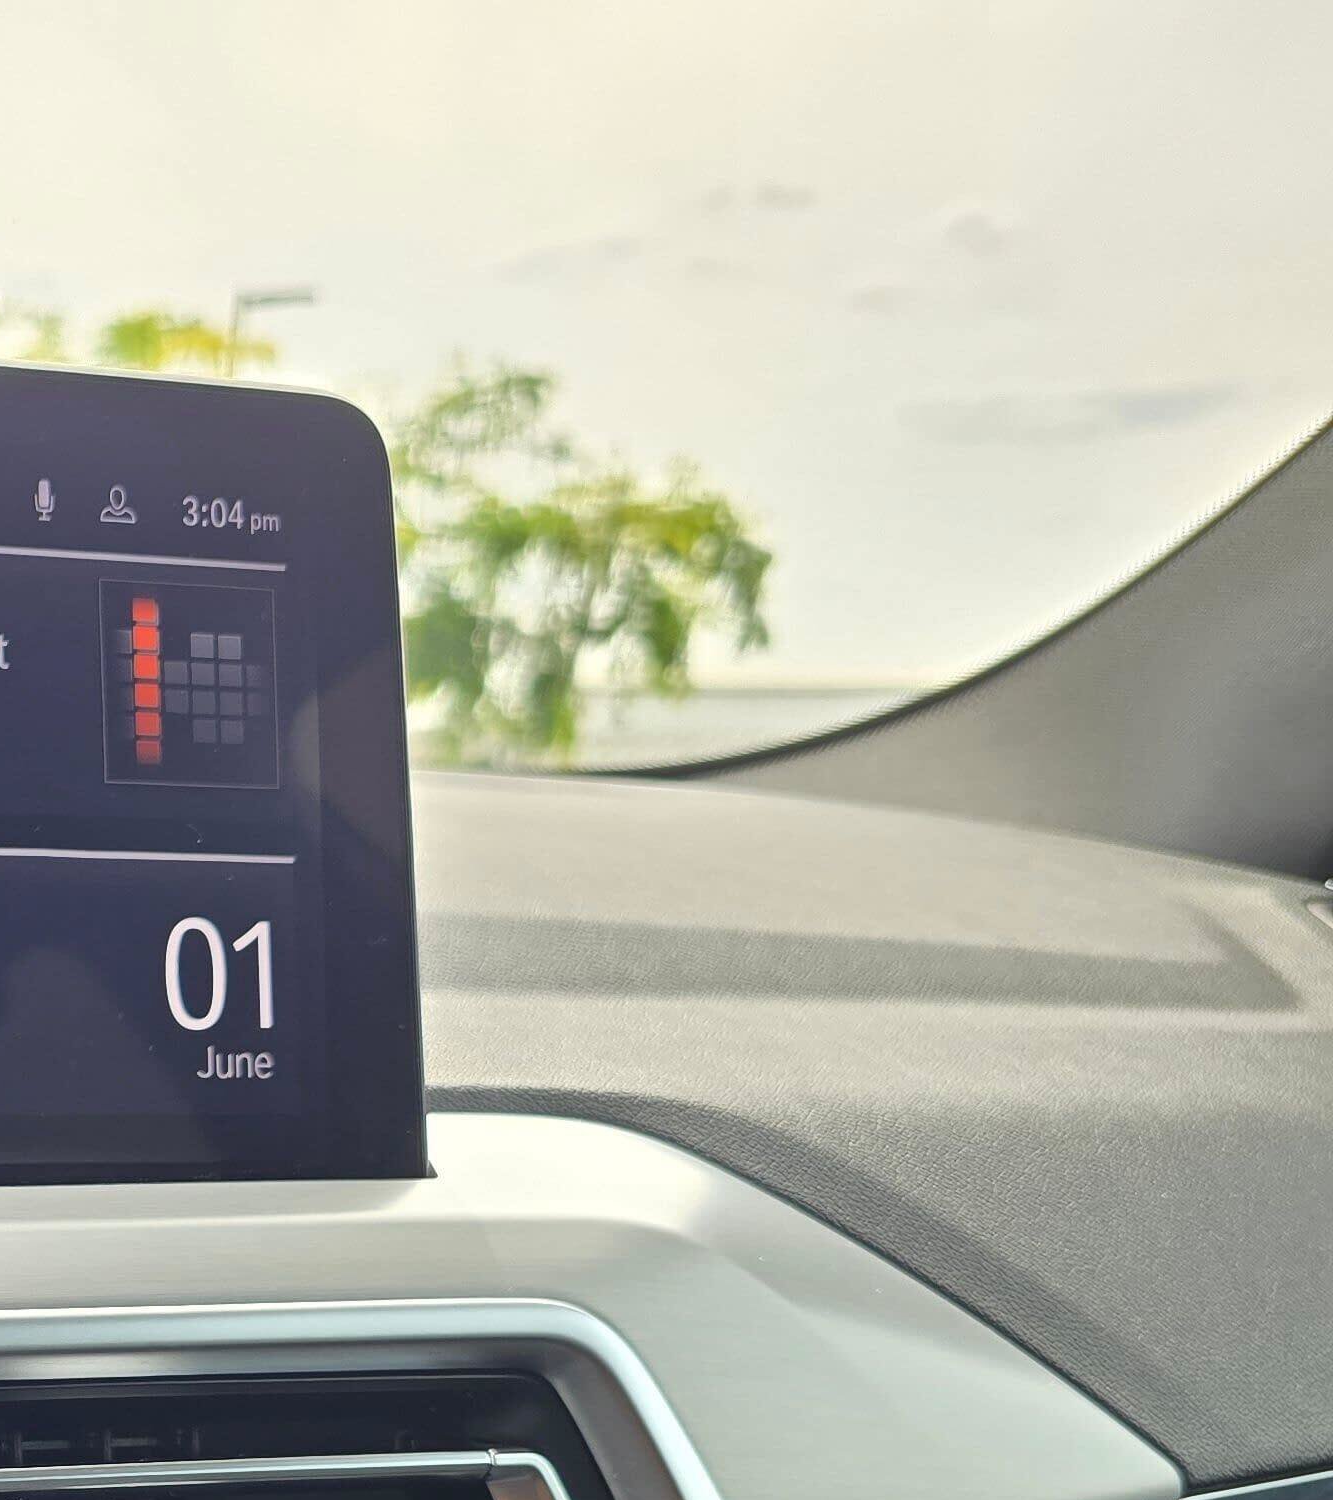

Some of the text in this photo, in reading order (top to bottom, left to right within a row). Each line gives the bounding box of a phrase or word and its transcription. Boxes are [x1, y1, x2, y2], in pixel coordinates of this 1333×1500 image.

[181, 495, 280, 533] 3:04 pm
[163, 916, 276, 1032] 01
[197, 1045, 275, 1081] June
